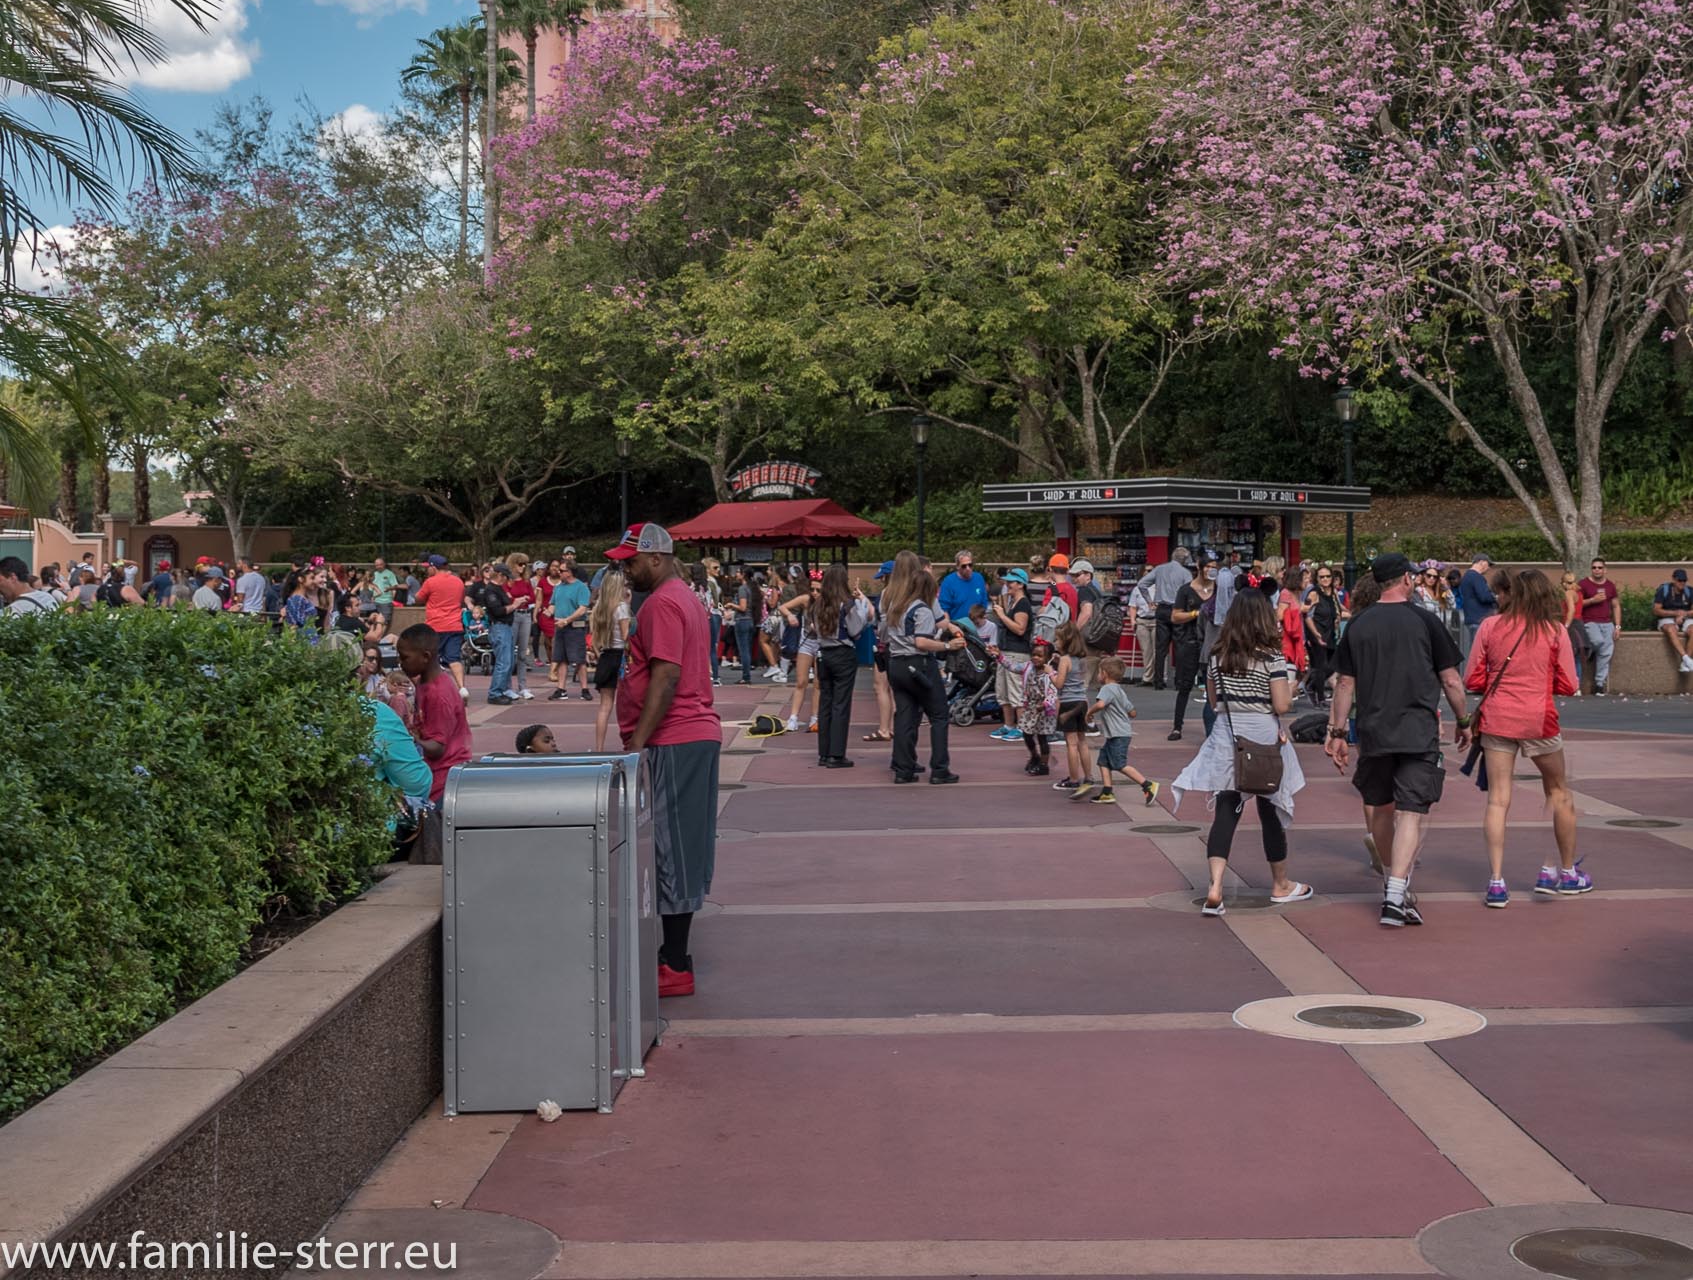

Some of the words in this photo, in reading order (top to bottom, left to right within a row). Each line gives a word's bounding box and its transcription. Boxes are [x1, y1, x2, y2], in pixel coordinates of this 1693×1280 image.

[1043, 490, 1065, 501] SHOP
[1080, 489, 1101, 500] ROLL
[1250, 490, 1268, 501] SHOP
[1280, 491, 1296, 502] ROLL
